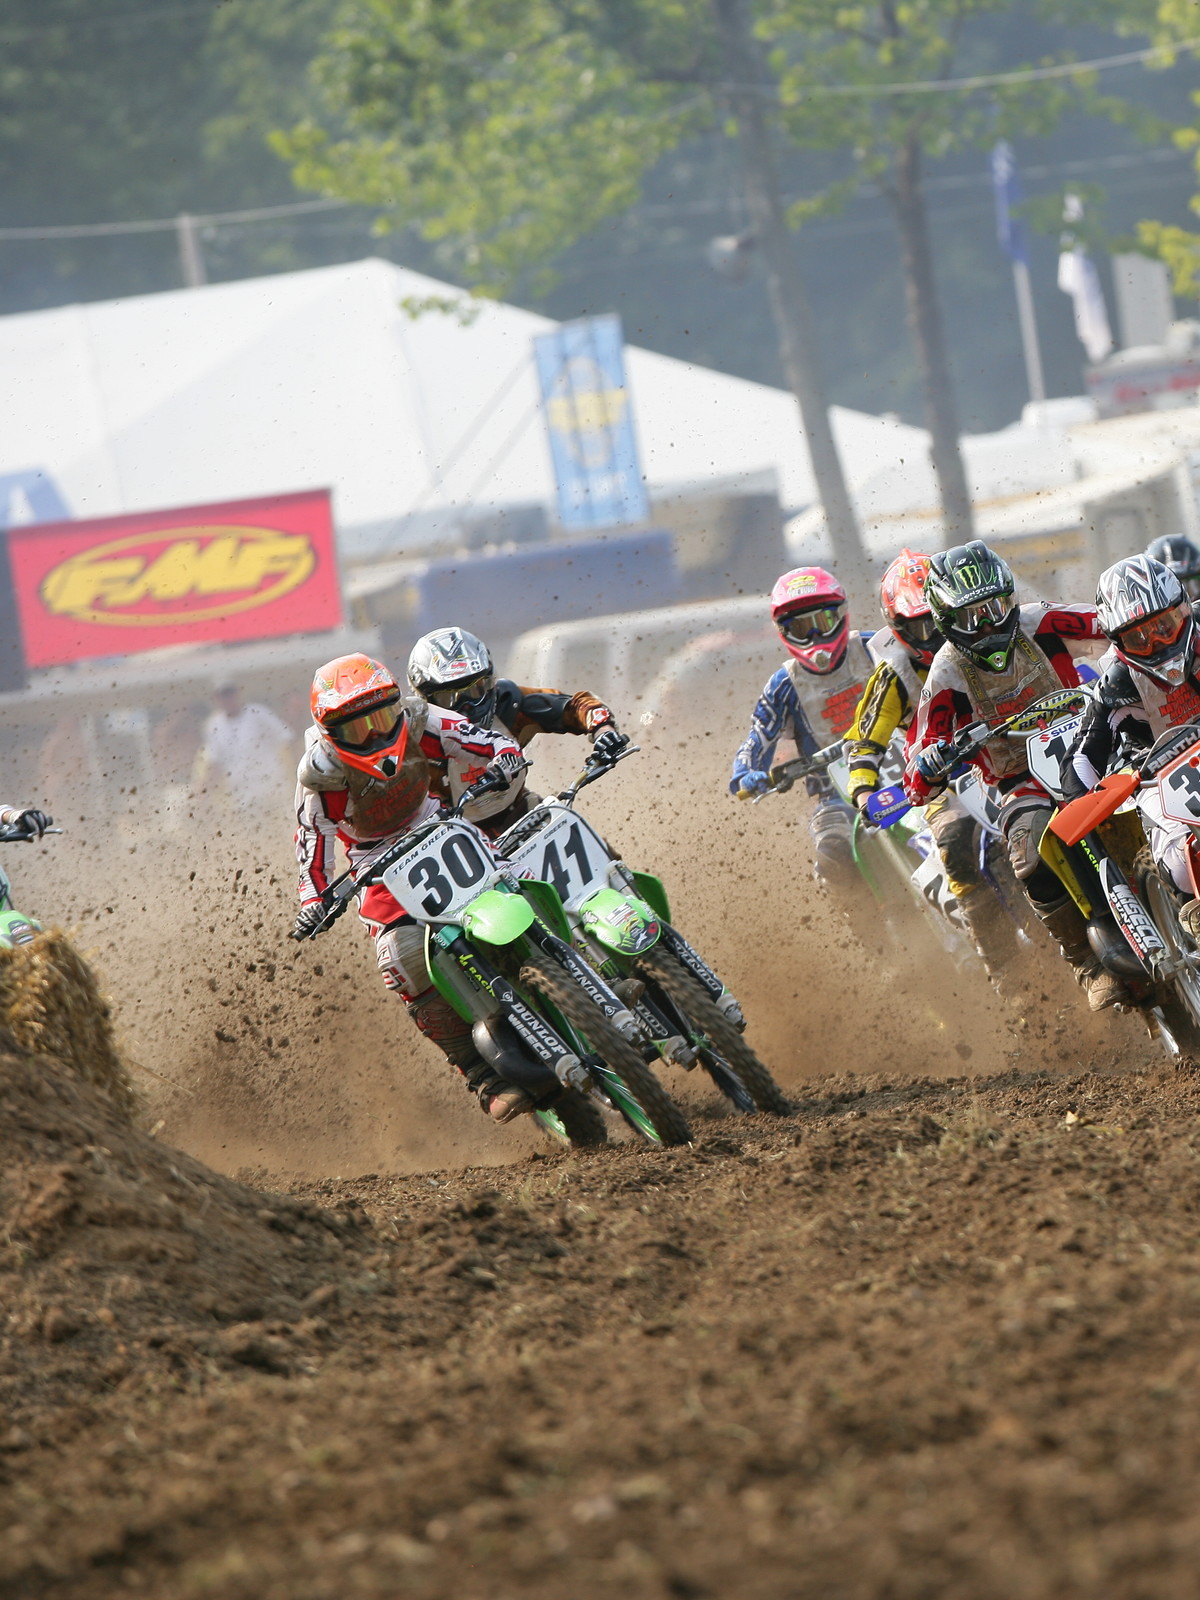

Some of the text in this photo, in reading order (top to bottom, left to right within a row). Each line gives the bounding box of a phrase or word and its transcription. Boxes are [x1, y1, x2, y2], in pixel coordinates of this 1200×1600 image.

[46, 533, 311, 614] FMF
[393, 850, 419, 876] TEAM
[421, 824, 455, 852] GREEN
[517, 842, 537, 862] TEAM
[543, 817, 568, 840] GREEN
[541, 821, 594, 904] 41
[1080, 838, 1102, 873] RACIN
[407, 833, 487, 918] 30
[1109, 892, 1149, 954] DUNLOP
[1111, 883, 1165, 949] WISECO
[468, 966, 496, 998] RACIN
[507, 1013, 553, 1061] WISECO
[510, 1001, 568, 1055] DUNLOP
